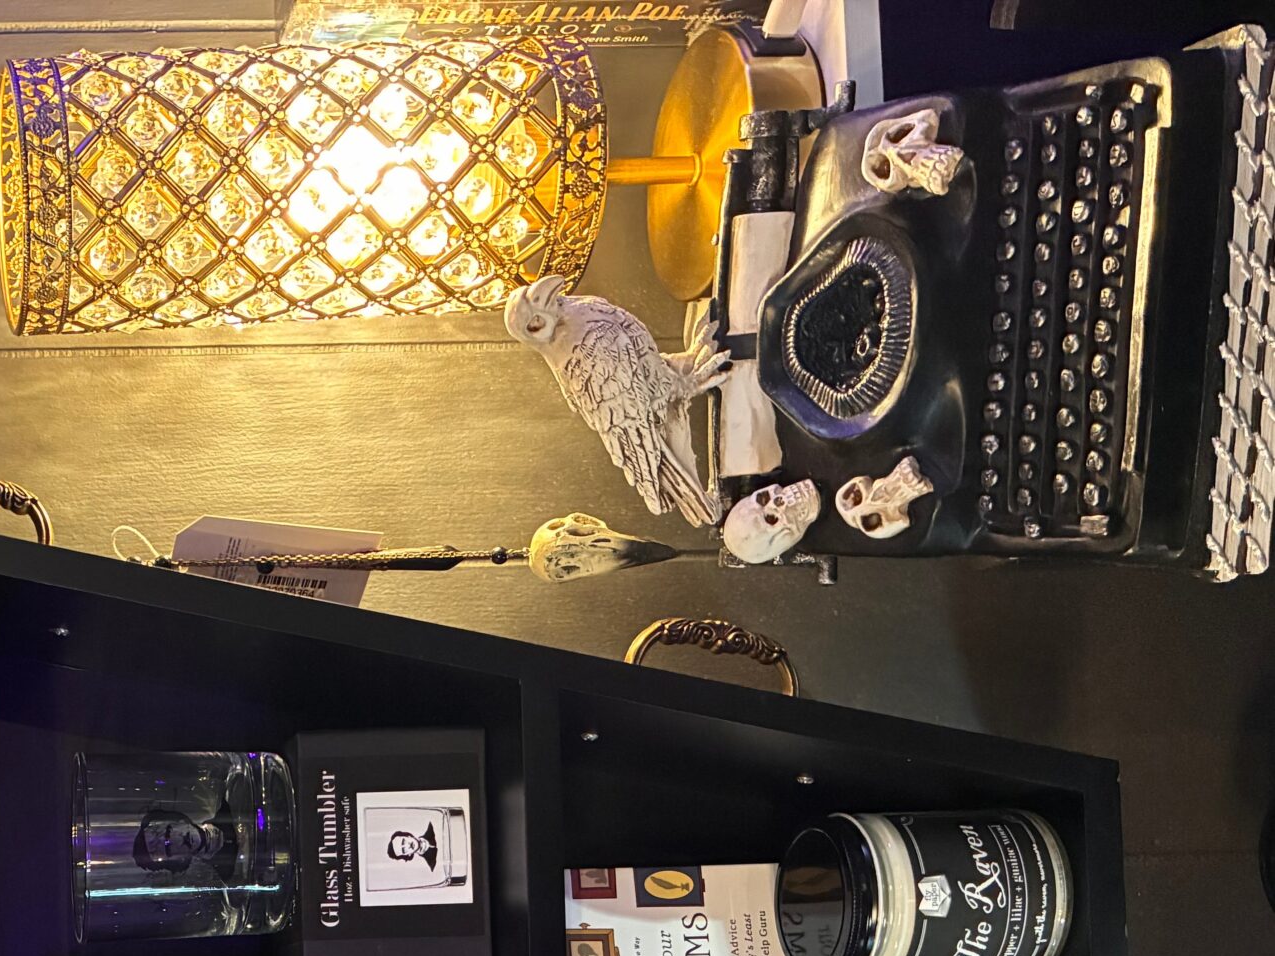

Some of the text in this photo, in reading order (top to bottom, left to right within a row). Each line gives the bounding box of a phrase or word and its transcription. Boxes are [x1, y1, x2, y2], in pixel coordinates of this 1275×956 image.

[522, 3, 622, 26] ALLAN
[628, 2, 689, 21] POE
[340, 795, 351, 815] safe
[341, 817, 352, 873] Dishwasher
[990, 824, 1011, 845] wood
[316, 770, 340, 928] Glass Tumbler
[1032, 843, 1046, 881] nevermore
[957, 824, 1007, 914] Raven
[1006, 846, 1024, 883] guaiac
[924, 890, 934, 903] fly
[929, 881, 940, 907] paper
[1010, 895, 1023, 922] lilac
[728, 918, 740, 956] Advice
[743, 912, 754, 942] Least
[758, 910, 768, 937] Guru
[633, 936, 641, 950] Way
